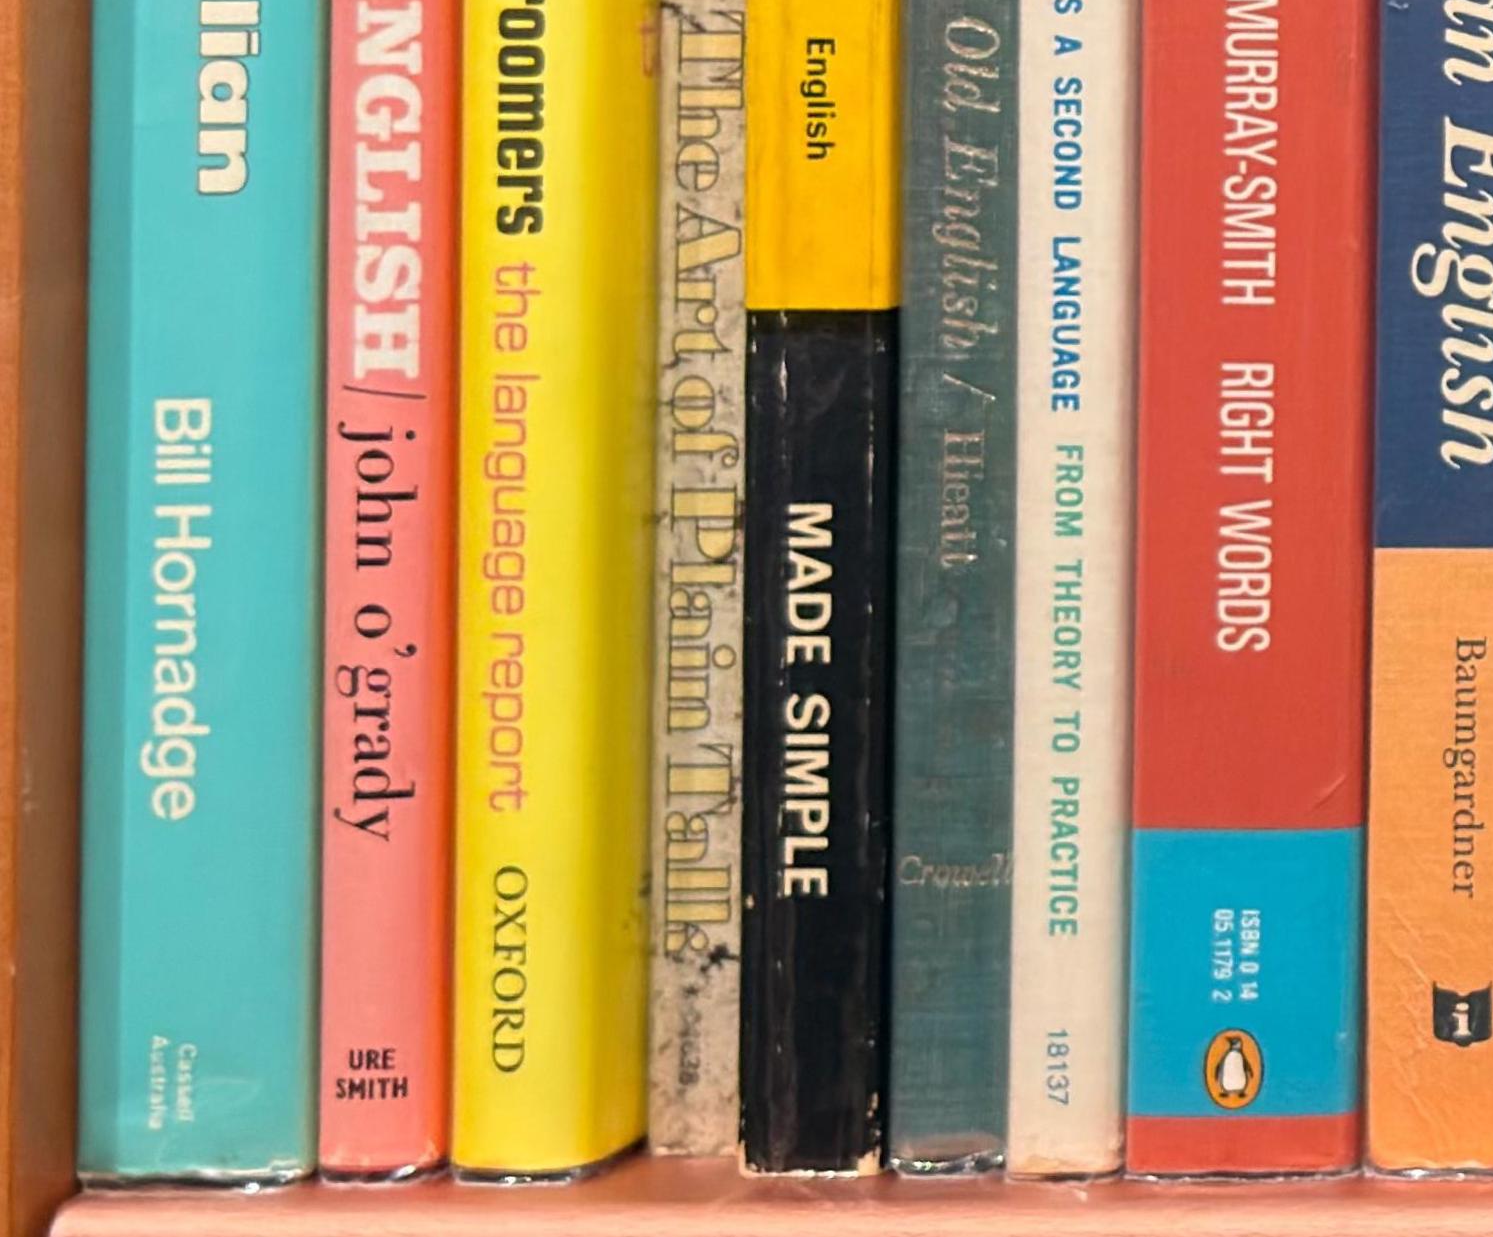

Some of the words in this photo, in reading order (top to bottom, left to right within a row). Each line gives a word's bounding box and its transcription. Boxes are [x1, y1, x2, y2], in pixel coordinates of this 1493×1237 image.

[676, 10, 744, 192] The
[802, 36, 836, 160] English
[943, 16, 1000, 112] Old
[1054, 35, 1083, 56] A
[1053, 76, 1083, 210] SECOND
[494, 260, 536, 358] the
[672, 202, 741, 364] Art
[932, 135, 999, 350] English
[1049, 236, 1083, 412] LANGUAGE
[153, 398, 211, 484] Bill
[671, 374, 739, 467] of
[1219, 363, 1274, 483] RIGHT
[337, 424, 418, 572] john
[482, 375, 534, 617] language
[1052, 444, 1083, 537] FROM
[668, 488, 737, 733] Plain
[785, 503, 834, 663] MADE
[1050, 559, 1083, 690] THEORY
[1217, 499, 1271, 652] WORDS
[141, 504, 213, 820] Hornadge
[333, 604, 416, 842] o'grady
[481, 632, 532, 812] report
[785, 694, 832, 897] SIMPLE
[1050, 712, 1080, 753] TO
[1444, 634, 1487, 898] Baumgardner
[664, 743, 732, 957] Talk
[1049, 778, 1080, 936] PRACTICE
[492, 864, 528, 1073] OXFORD
[1212, 989, 1232, 1001] 2
[1239, 962, 1259, 973] 0
[1240, 981, 1258, 1000] 14
[1241, 910, 1260, 954] ISBN
[336, 1077, 408, 1100] SMITH
[349, 1048, 395, 1071] URE
[1047, 1029, 1069, 1105] 18137
